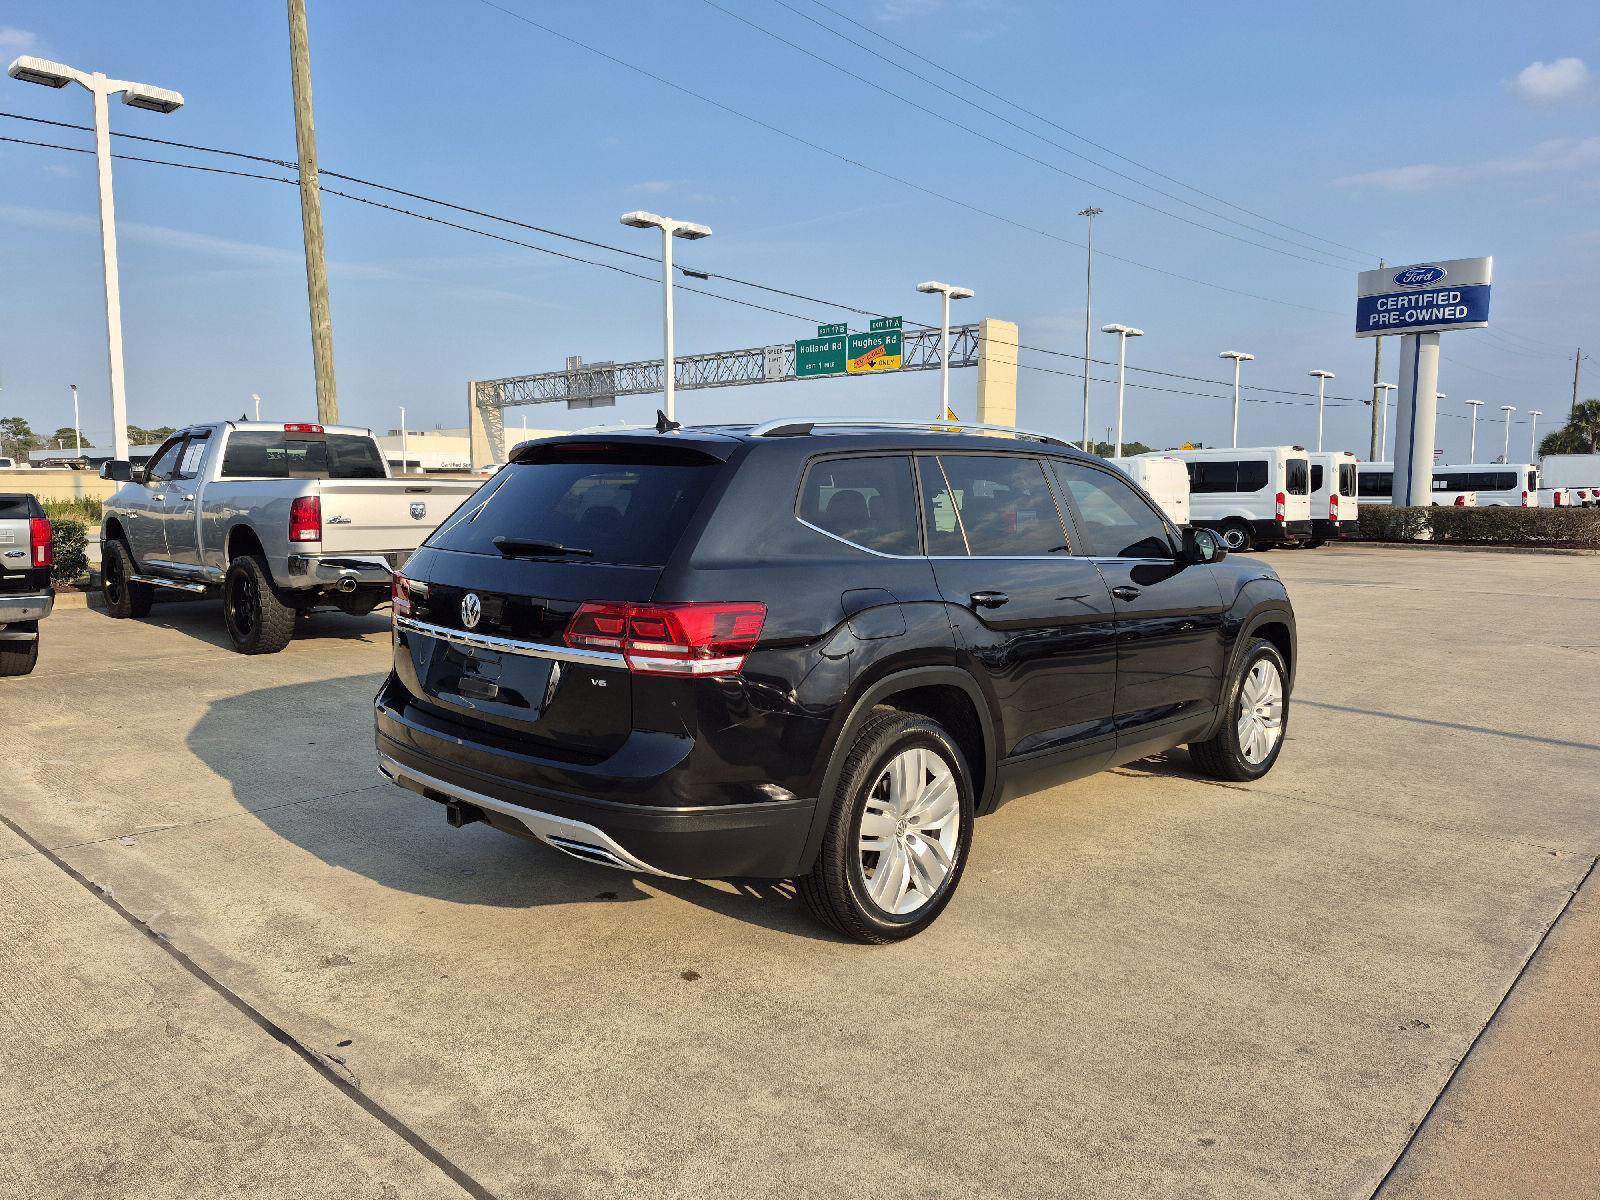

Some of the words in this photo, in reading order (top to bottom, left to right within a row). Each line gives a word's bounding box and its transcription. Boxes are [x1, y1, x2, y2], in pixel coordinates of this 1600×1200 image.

[1377, 291, 1461, 310] CERTIFIED
[1370, 306, 1468, 325] PRE-OWNED
[800, 342, 829, 353] Holland
[832, 342, 842, 350] Rd
[852, 338, 882, 348] Hughes
[886, 335, 897, 344] Rd
